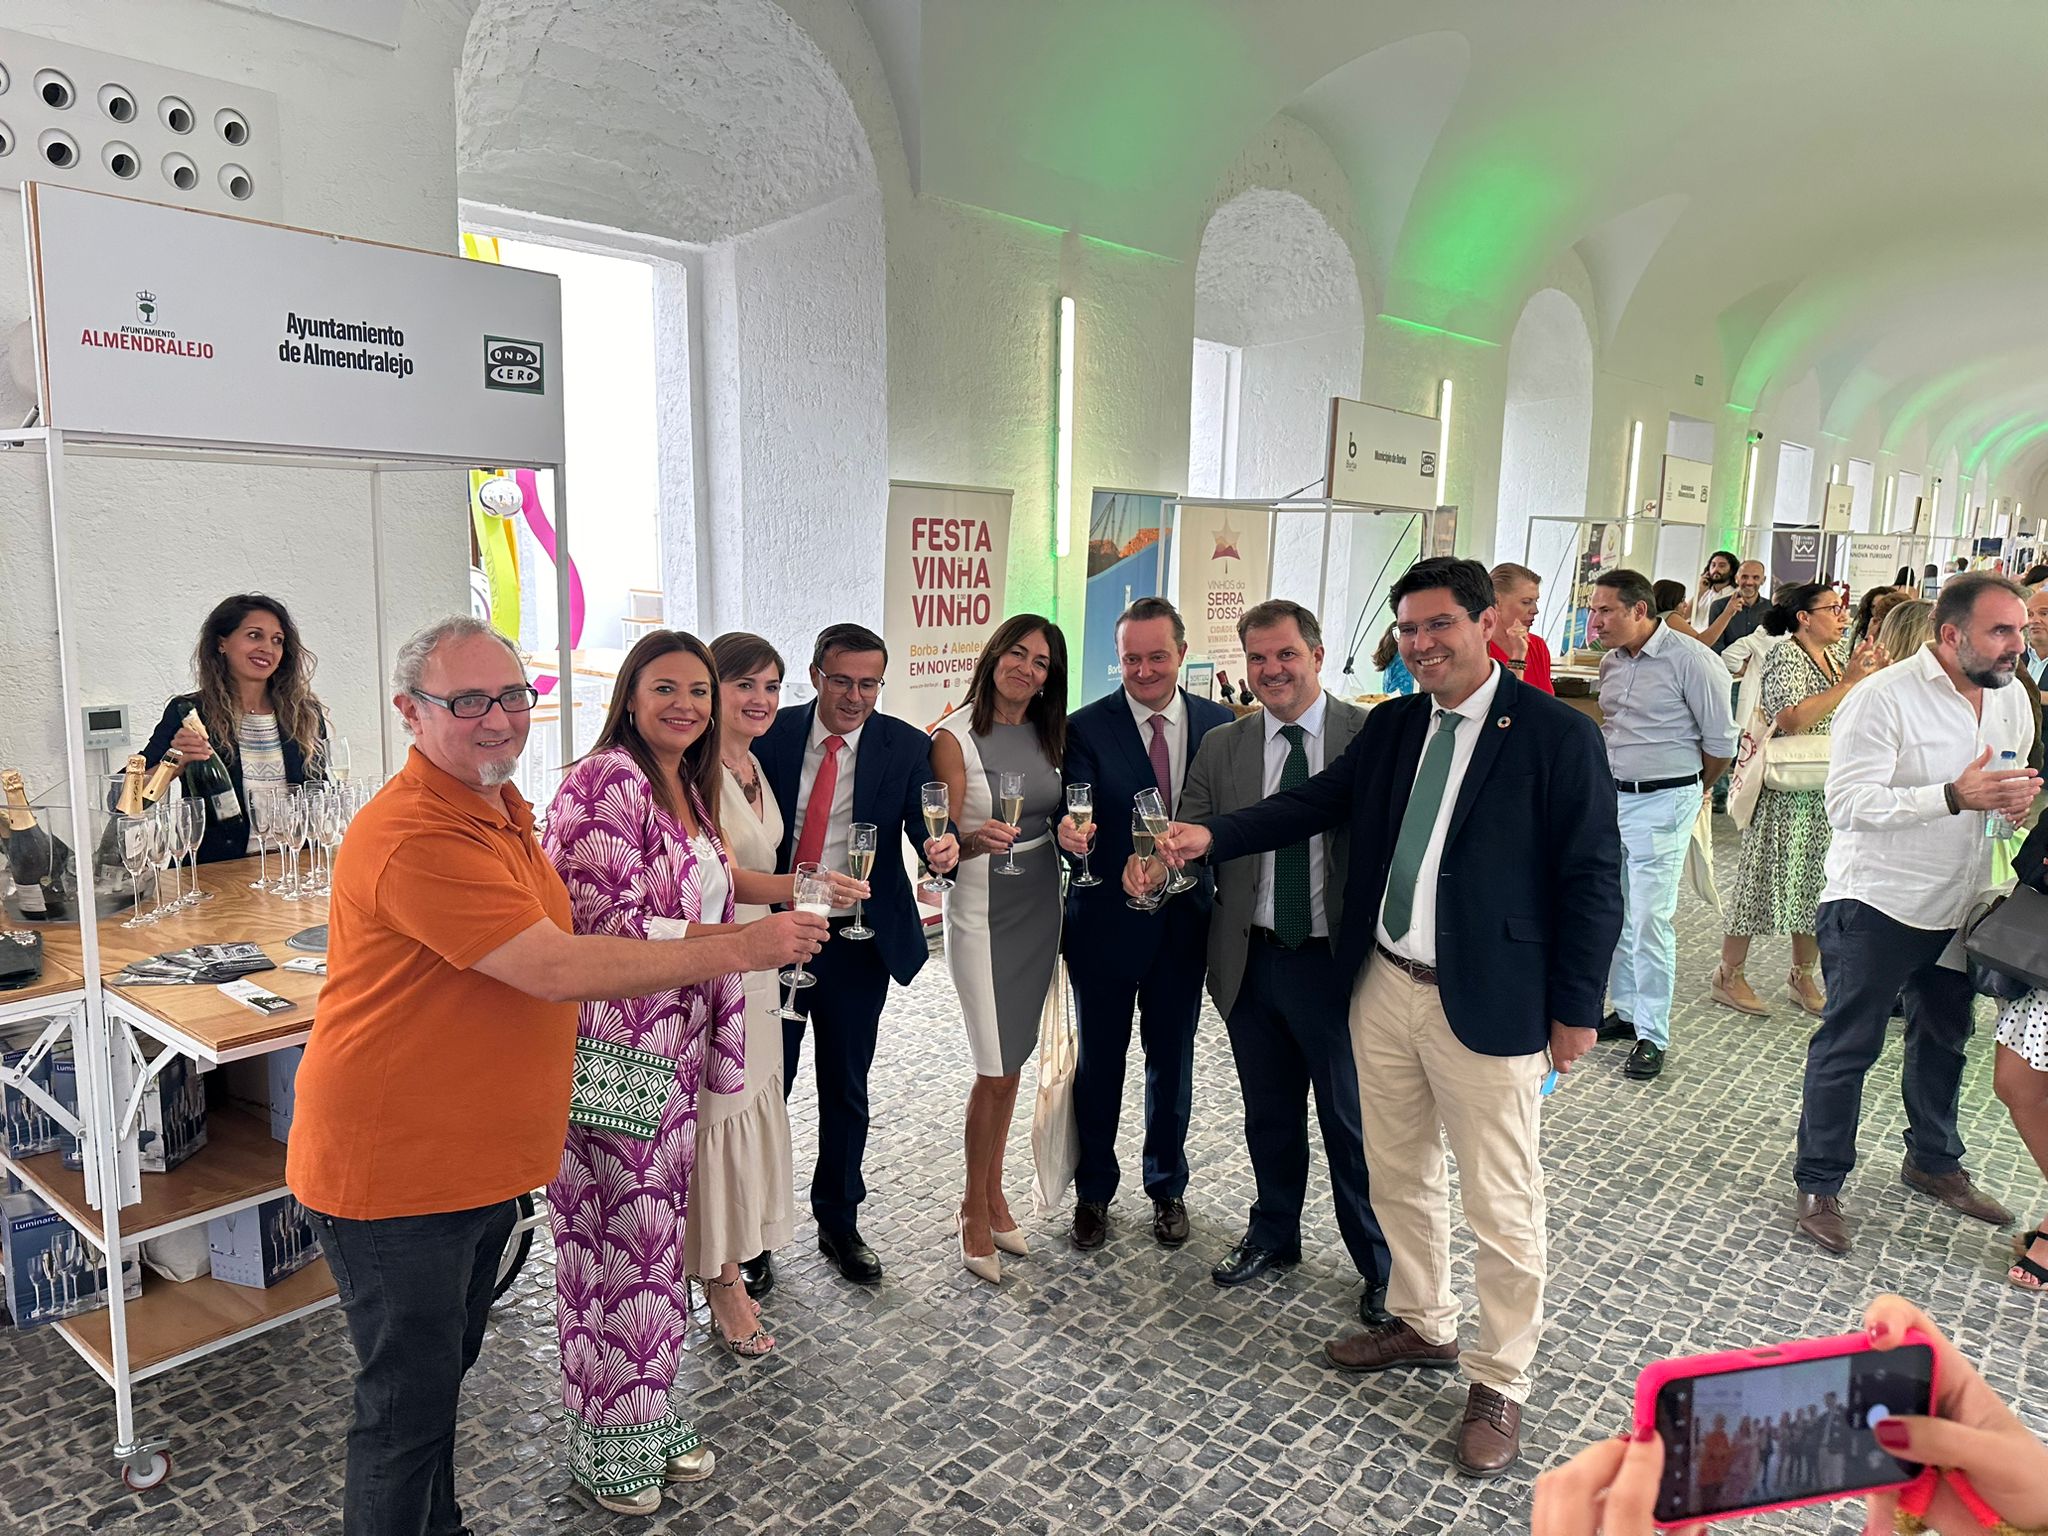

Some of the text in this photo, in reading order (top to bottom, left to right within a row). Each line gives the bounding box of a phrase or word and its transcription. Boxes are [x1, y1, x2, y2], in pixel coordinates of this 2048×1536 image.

[120, 325, 176, 339] AYUNTAMIENTO
[286, 312, 405, 347] Ayuntamiento
[81, 329, 214, 359] ALMENDRALEJO
[279, 339, 414, 379] de Almendralejo
[494, 350, 534, 363] ONDA
[497, 368, 534, 381] CERO
[912, 517, 992, 552] FESTA
[912, 556, 991, 589] VINHA
[1207, 579, 1235, 590] VINHOS
[1207, 592, 1245, 606] SERRA
[911, 593, 991, 628] VINHO
[1207, 606, 1245, 620] D'OSSA
[910, 643, 938, 657] Borba
[910, 661, 925, 676] EM
[1107, 664, 1122, 675] Borb
[15, 1215, 57, 1230] Luminarc
